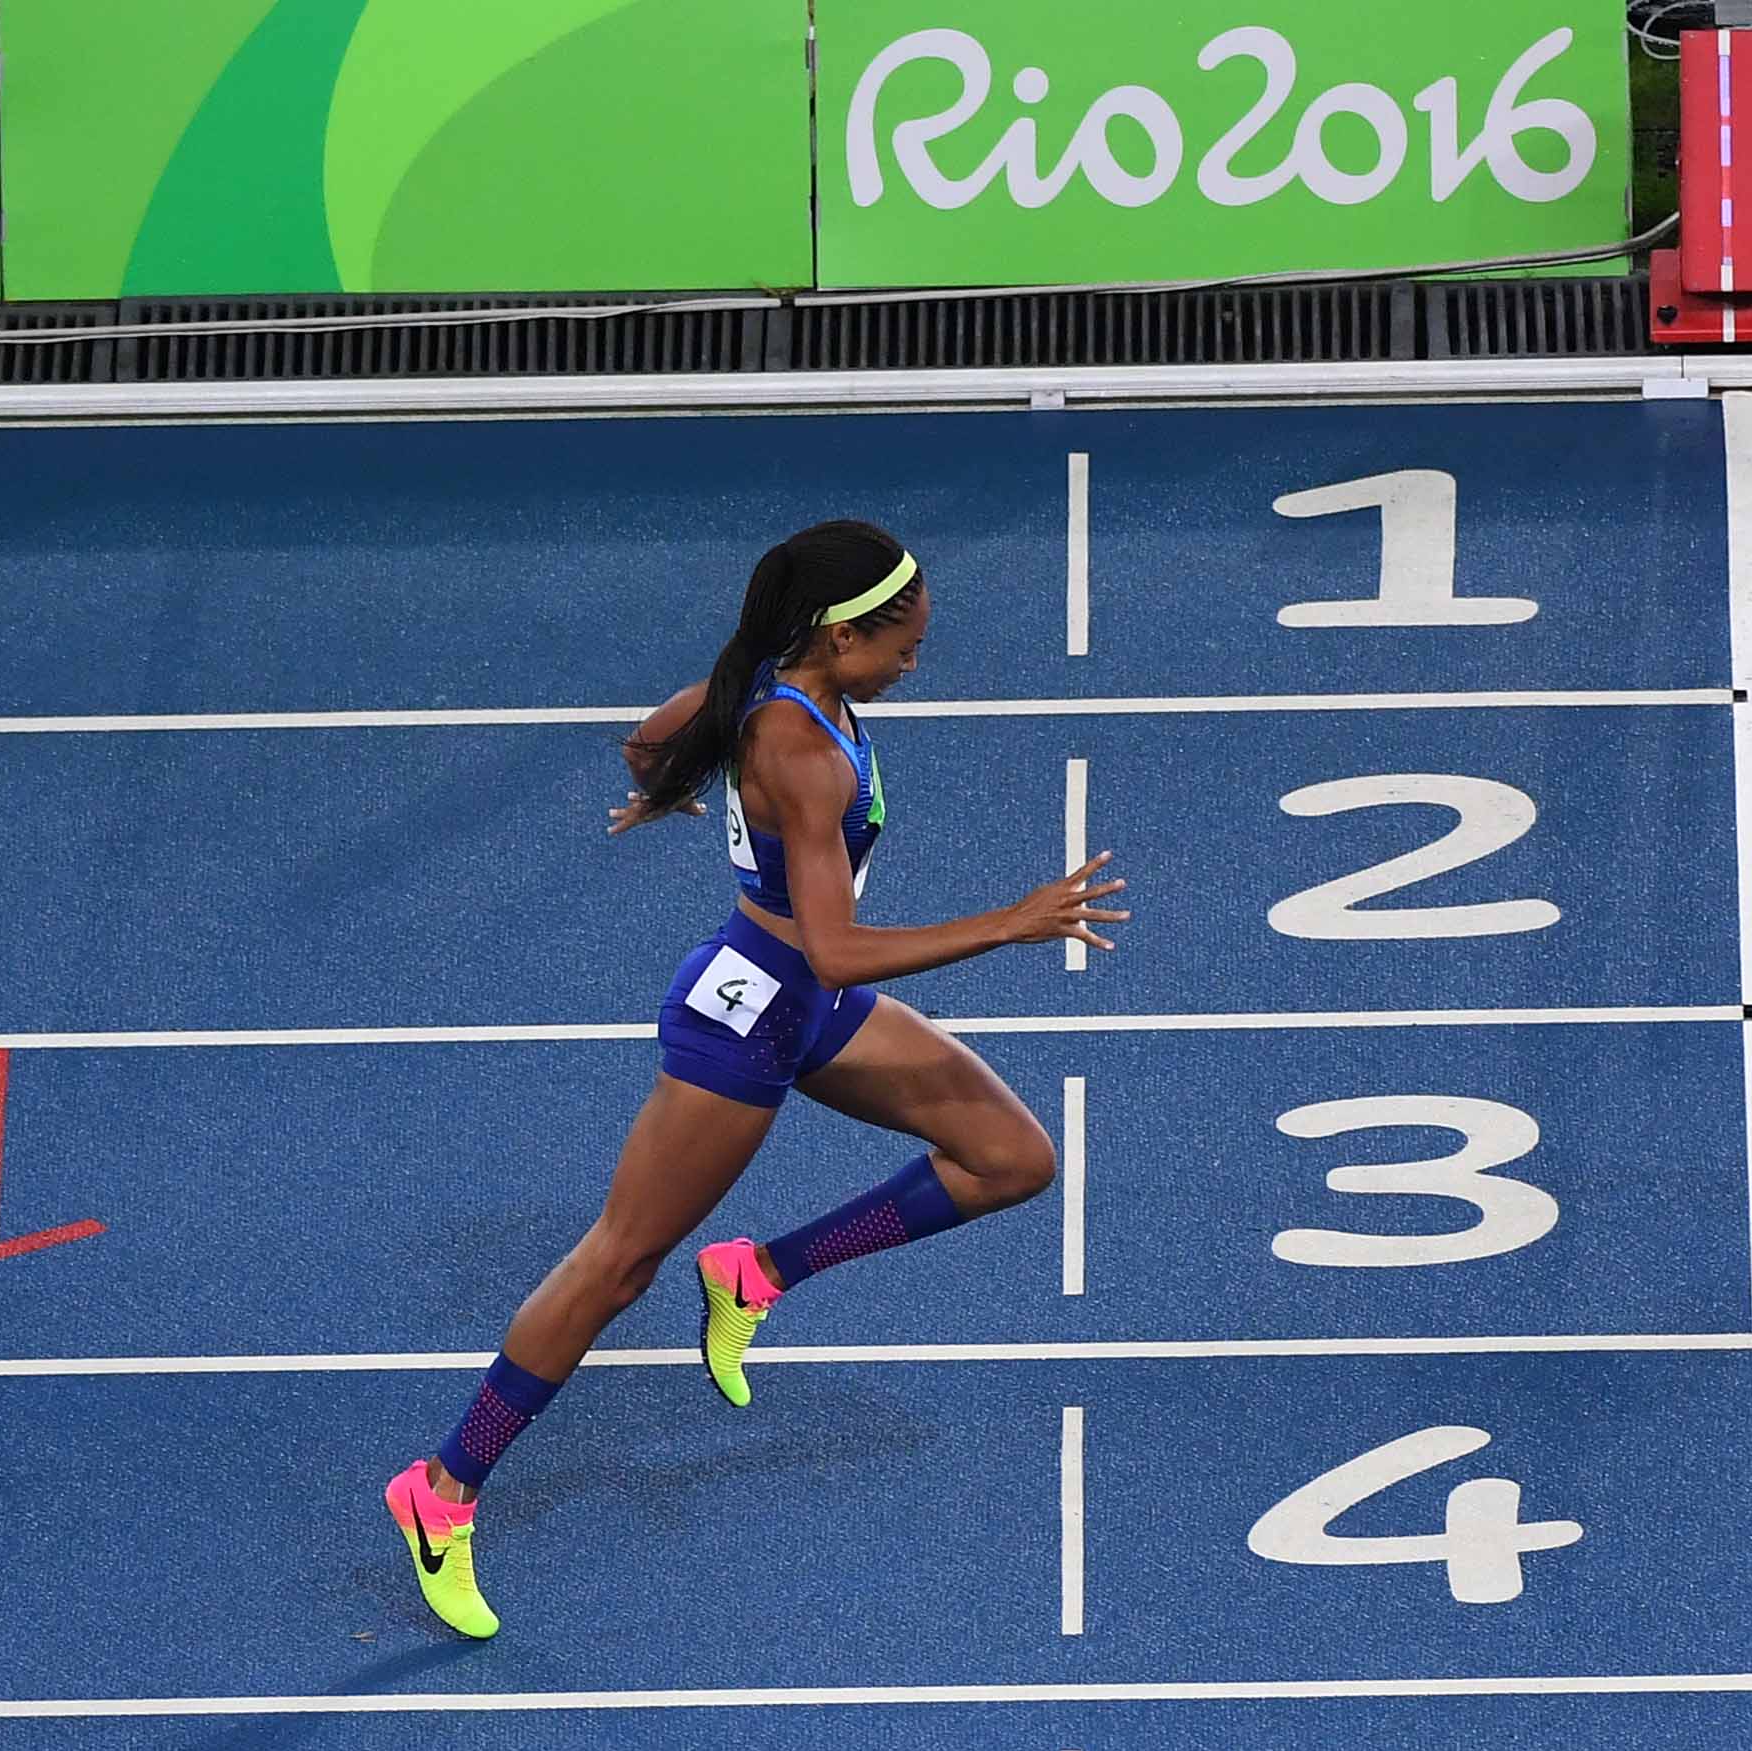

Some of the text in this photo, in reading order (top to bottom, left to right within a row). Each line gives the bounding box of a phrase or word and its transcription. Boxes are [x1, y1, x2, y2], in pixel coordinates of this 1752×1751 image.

[1273, 470, 1539, 627] 1
[1268, 774, 1561, 939] 2
[716, 979, 748, 1012] 4
[1272, 1095, 1559, 1267] 3
[1247, 1426, 1584, 1604] 4
